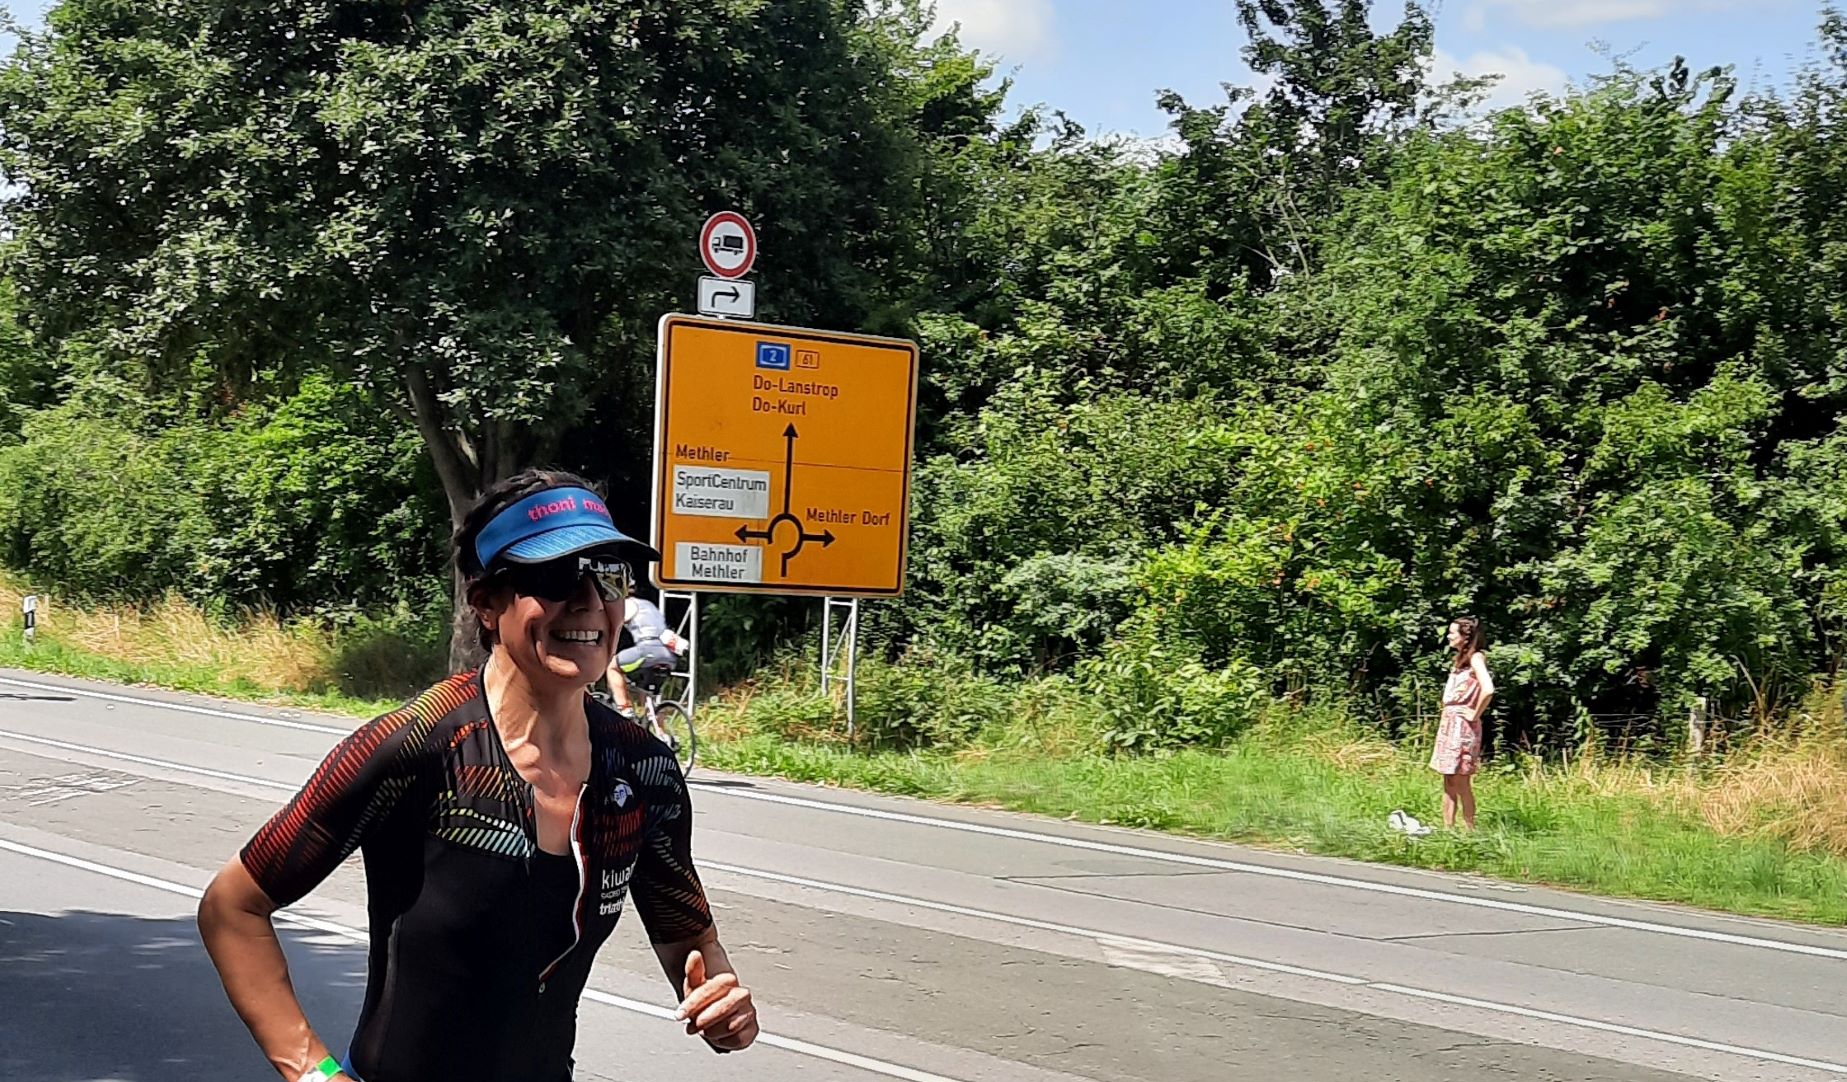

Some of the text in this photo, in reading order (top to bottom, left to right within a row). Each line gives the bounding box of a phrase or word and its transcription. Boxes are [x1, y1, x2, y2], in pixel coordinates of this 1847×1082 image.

[769, 350, 777, 362] 2
[802, 354, 813, 365] 61
[753, 374, 839, 400] Do-Lanstrop
[752, 396, 807, 416] Do-Kurl
[675, 443, 730, 462] Methler
[677, 471, 767, 491] SportCentrum
[675, 492, 734, 510] Kaiserau
[805, 507, 891, 526] Methler Dorf
[690, 546, 748, 563] Bahnhof
[691, 563, 745, 579] Methler
